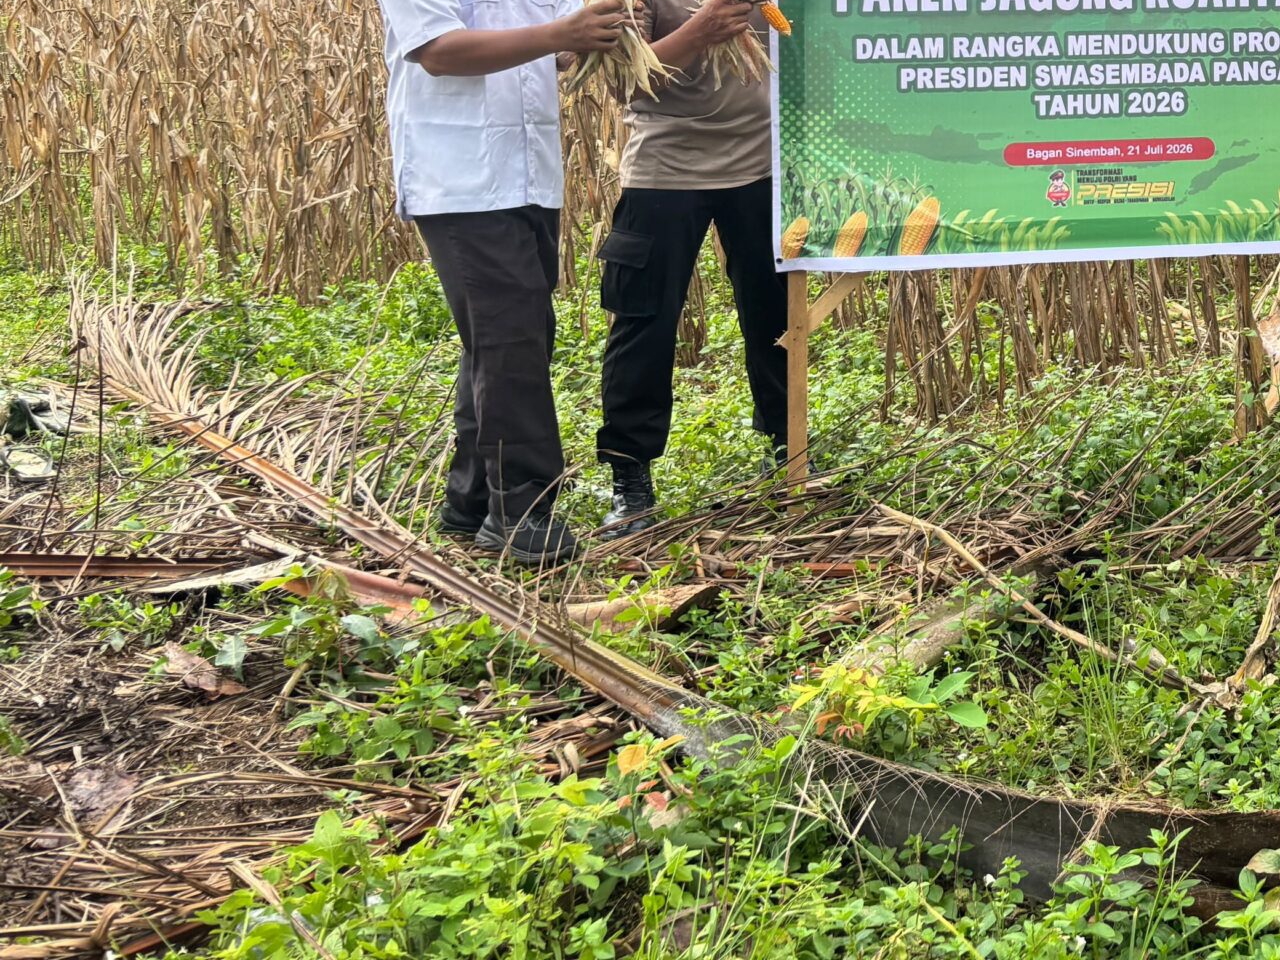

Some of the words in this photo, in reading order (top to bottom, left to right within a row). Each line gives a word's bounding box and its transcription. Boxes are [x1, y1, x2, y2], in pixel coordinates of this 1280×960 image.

[855, 37, 945, 60] DALAM
[952, 35, 1060, 58] RANGKA
[1067, 32, 1225, 56] MENDUKUNG
[900, 66, 1027, 90] PRESIDEN
[1034, 62, 1206, 87] SWASEMBADA
[1034, 93, 1120, 116] TAHUN
[1127, 91, 1185, 114] 2026
[1026, 148, 1063, 161] Bagan
[1065, 146, 1125, 158] Sinembah,
[1127, 145, 1141, 156] 21
[1144, 144, 1163, 156] Juli
[1166, 143, 1194, 155] 2026
[1076, 168, 1123, 176] TRANSFORMASI
[1077, 181, 1175, 202] PRESISI
